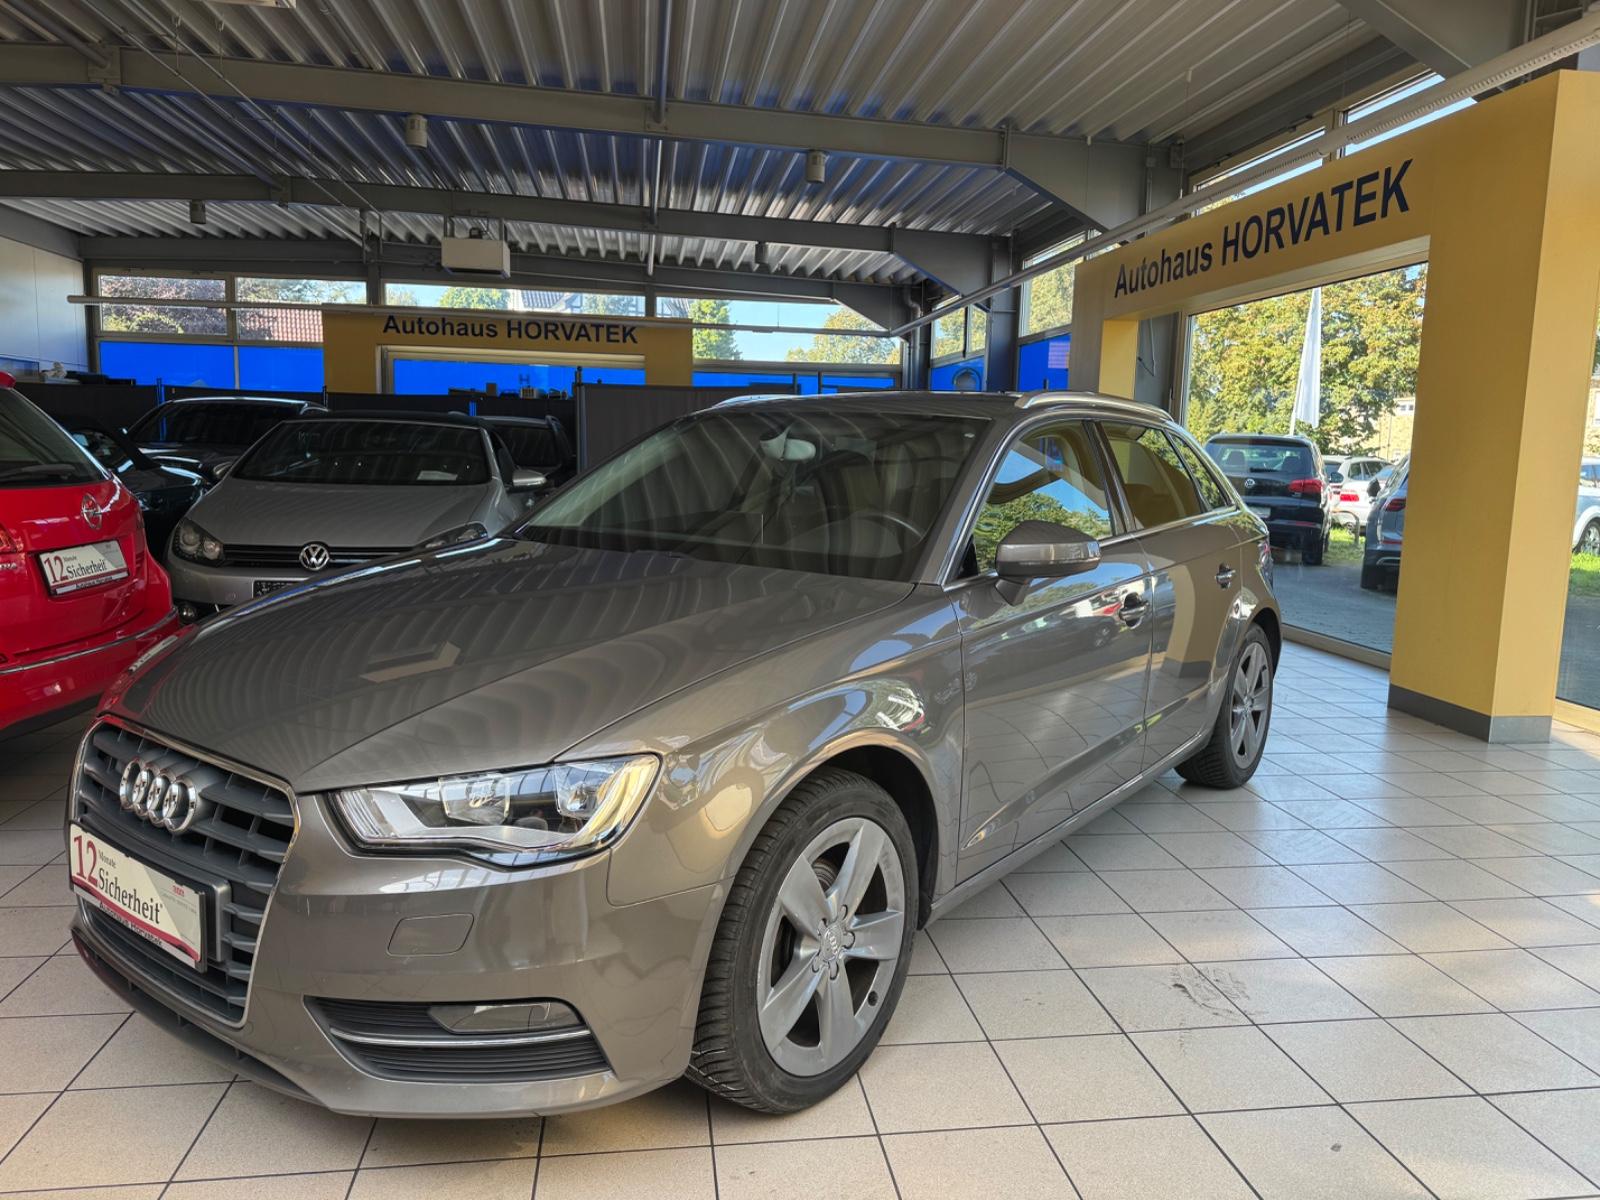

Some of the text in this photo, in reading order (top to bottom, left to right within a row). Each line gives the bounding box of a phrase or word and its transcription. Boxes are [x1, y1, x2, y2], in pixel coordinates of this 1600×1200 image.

[1114, 158, 1414, 298] Autohaus HORVATEK
[382, 314, 639, 344] Autohaus HORVATEK
[44, 555, 69, 584] 12
[66, 559, 107, 579] Sicherheit
[73, 834, 98, 888] 12
[98, 867, 161, 925] Sicherheit
